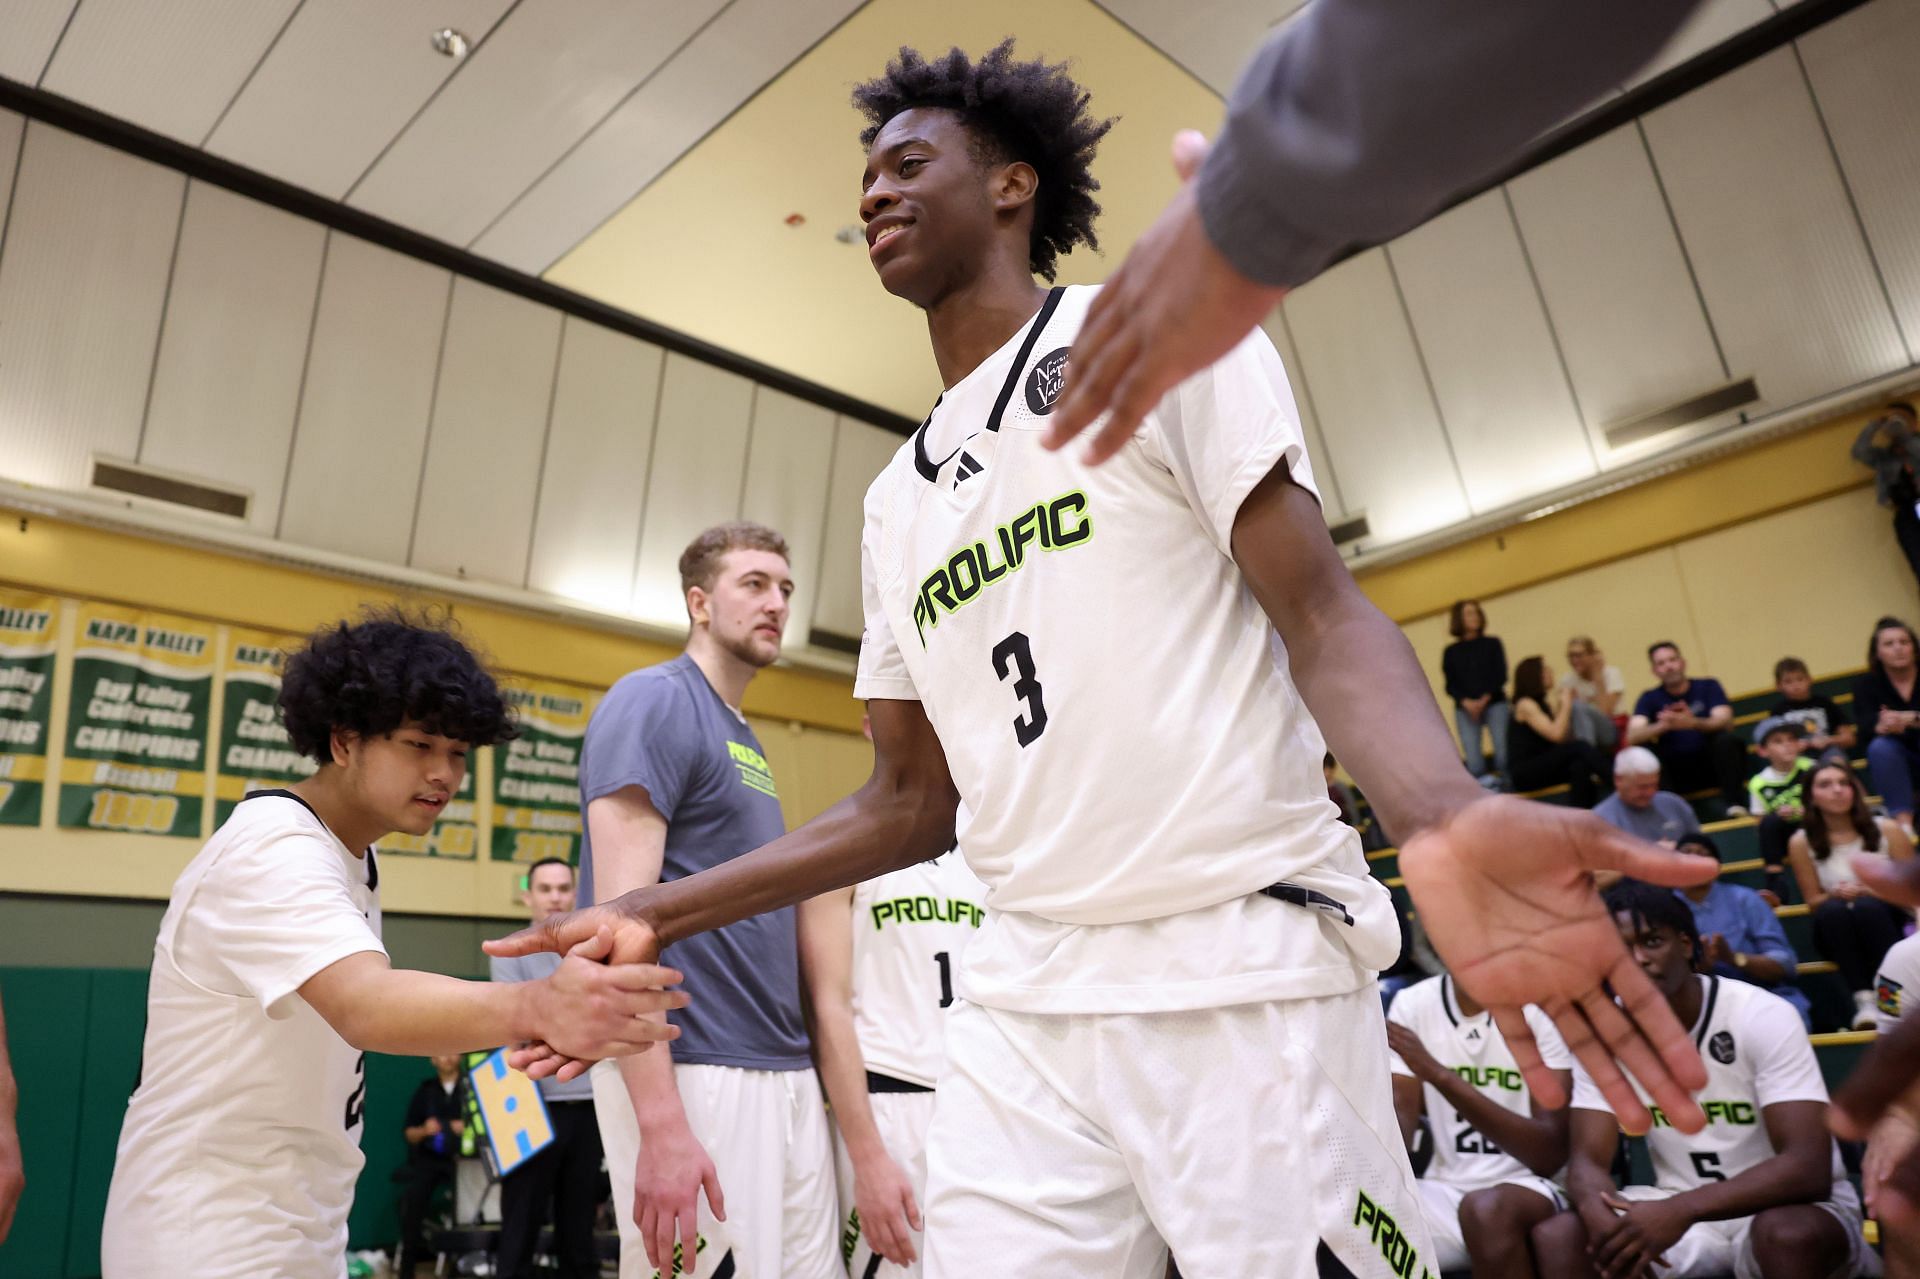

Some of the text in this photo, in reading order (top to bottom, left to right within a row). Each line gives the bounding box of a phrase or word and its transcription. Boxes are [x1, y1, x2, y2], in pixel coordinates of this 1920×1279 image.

[1035, 377, 1067, 407] Valle
[912, 490, 1093, 651] PROLIFIC
[0, 609, 50, 631] ALLEY
[87, 620, 206, 655] NAPA VALLEY
[136, 683, 192, 712] Valley
[991, 631, 1049, 749] 3
[87, 697, 195, 731] Conference
[74, 725, 201, 762] CHAMPIONS
[933, 952, 954, 1008] 1
